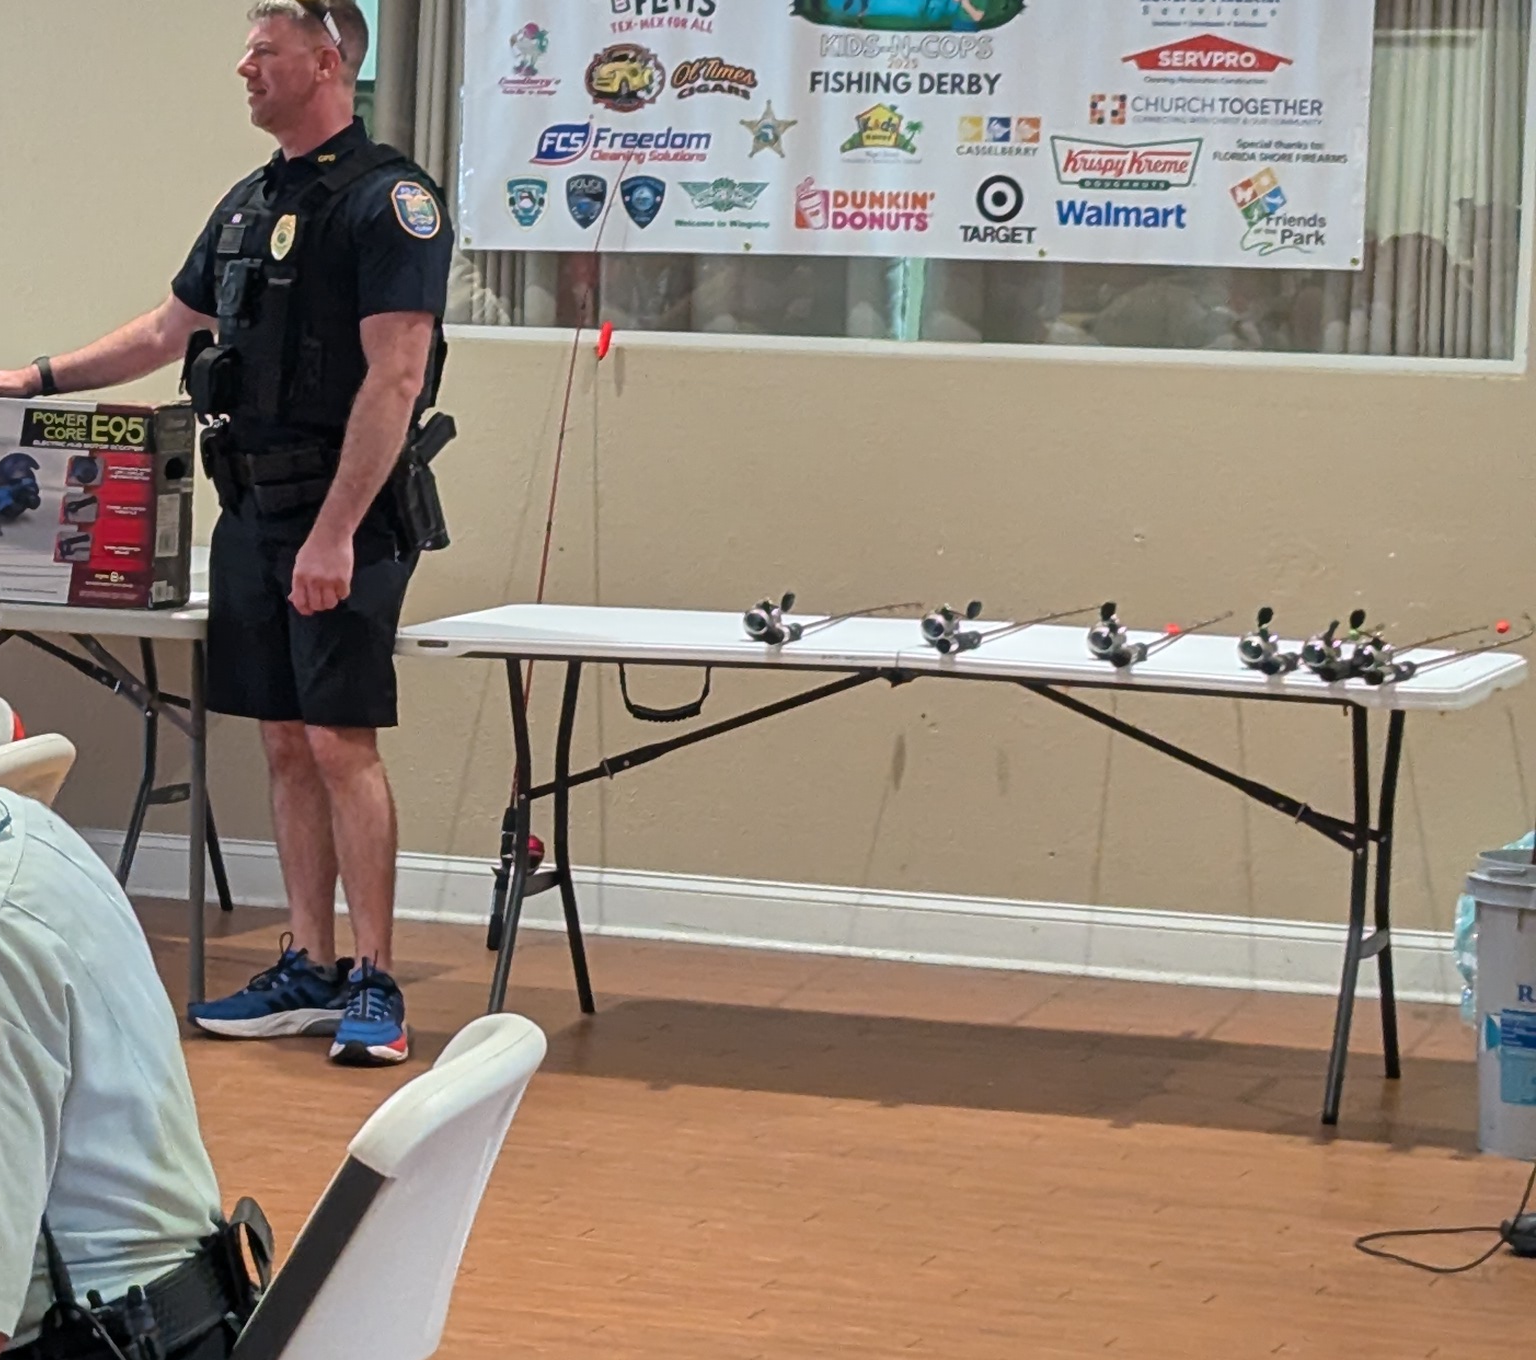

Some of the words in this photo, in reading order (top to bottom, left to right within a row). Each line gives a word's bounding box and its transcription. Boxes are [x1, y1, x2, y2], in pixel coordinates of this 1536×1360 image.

[667, 17, 688, 28] FOR
[691, 19, 714, 34] ALL
[819, 33, 995, 60] KIDS-N-COPS
[1157, 50, 1258, 69] SERVPRO
[704, 58, 757, 87] Times
[676, 83, 752, 101] CIGARS
[809, 71, 912, 94] FISHING
[918, 72, 1002, 95] DERBY
[1130, 95, 1214, 114] CHURCH
[1218, 97, 1324, 117] TOGETHER
[541, 132, 586, 153] FCS
[592, 126, 712, 150] Freedom
[589, 149, 647, 165] Cleaning
[647, 149, 707, 162] Solutions
[956, 146, 1040, 157] CASSELBERRY
[1213, 151, 1256, 162] FLORIDA
[1062, 149, 1130, 178] Krispy
[1127, 150, 1193, 175] Kreme
[832, 190, 936, 209] DUNKIN'
[831, 211, 930, 232] DONUTS
[1055, 200, 1188, 230] Walmart
[1265, 213, 1327, 228] Friends
[959, 225, 1037, 244] TARGET
[1280, 228, 1326, 246] Park
[32, 411, 88, 427] POWER
[43, 426, 87, 441] CORE
[91, 414, 145, 444] E95
